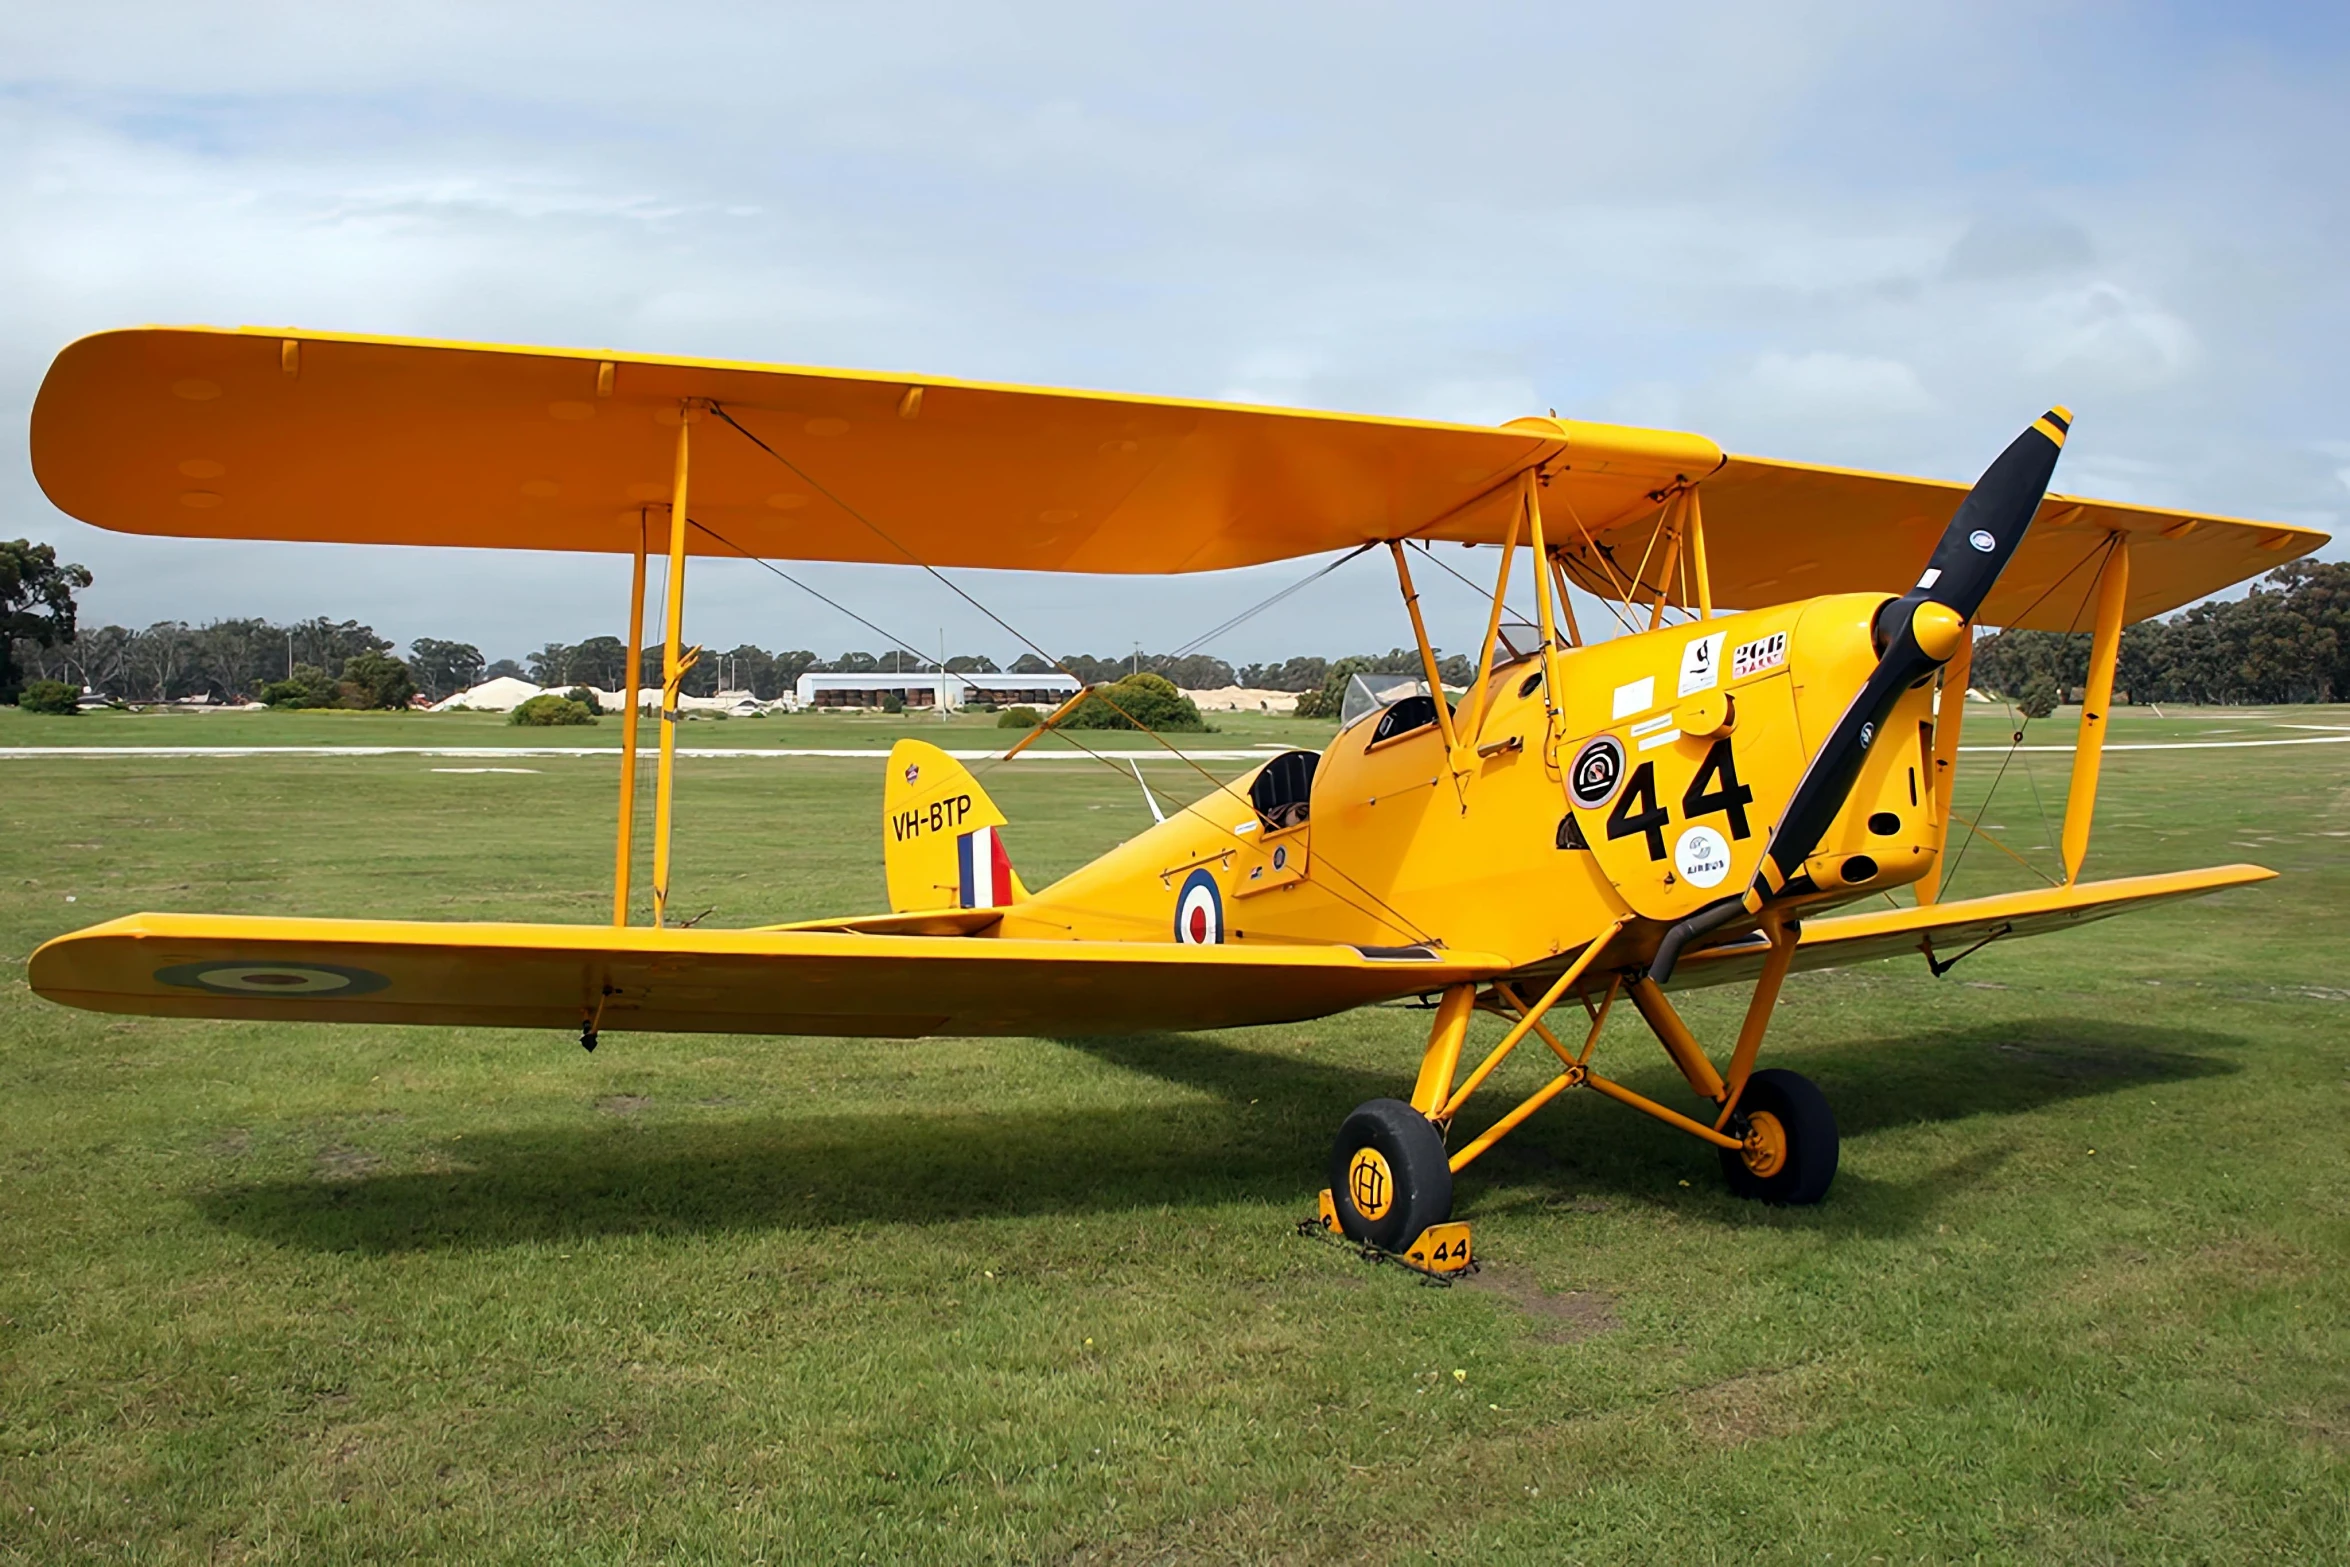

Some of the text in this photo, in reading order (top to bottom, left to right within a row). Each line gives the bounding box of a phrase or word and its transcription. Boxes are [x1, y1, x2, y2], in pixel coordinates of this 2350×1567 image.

[893, 794, 971, 842] VH-BTP
[1606, 737, 1753, 861] 44
[1433, 1239, 1467, 1262] 44
